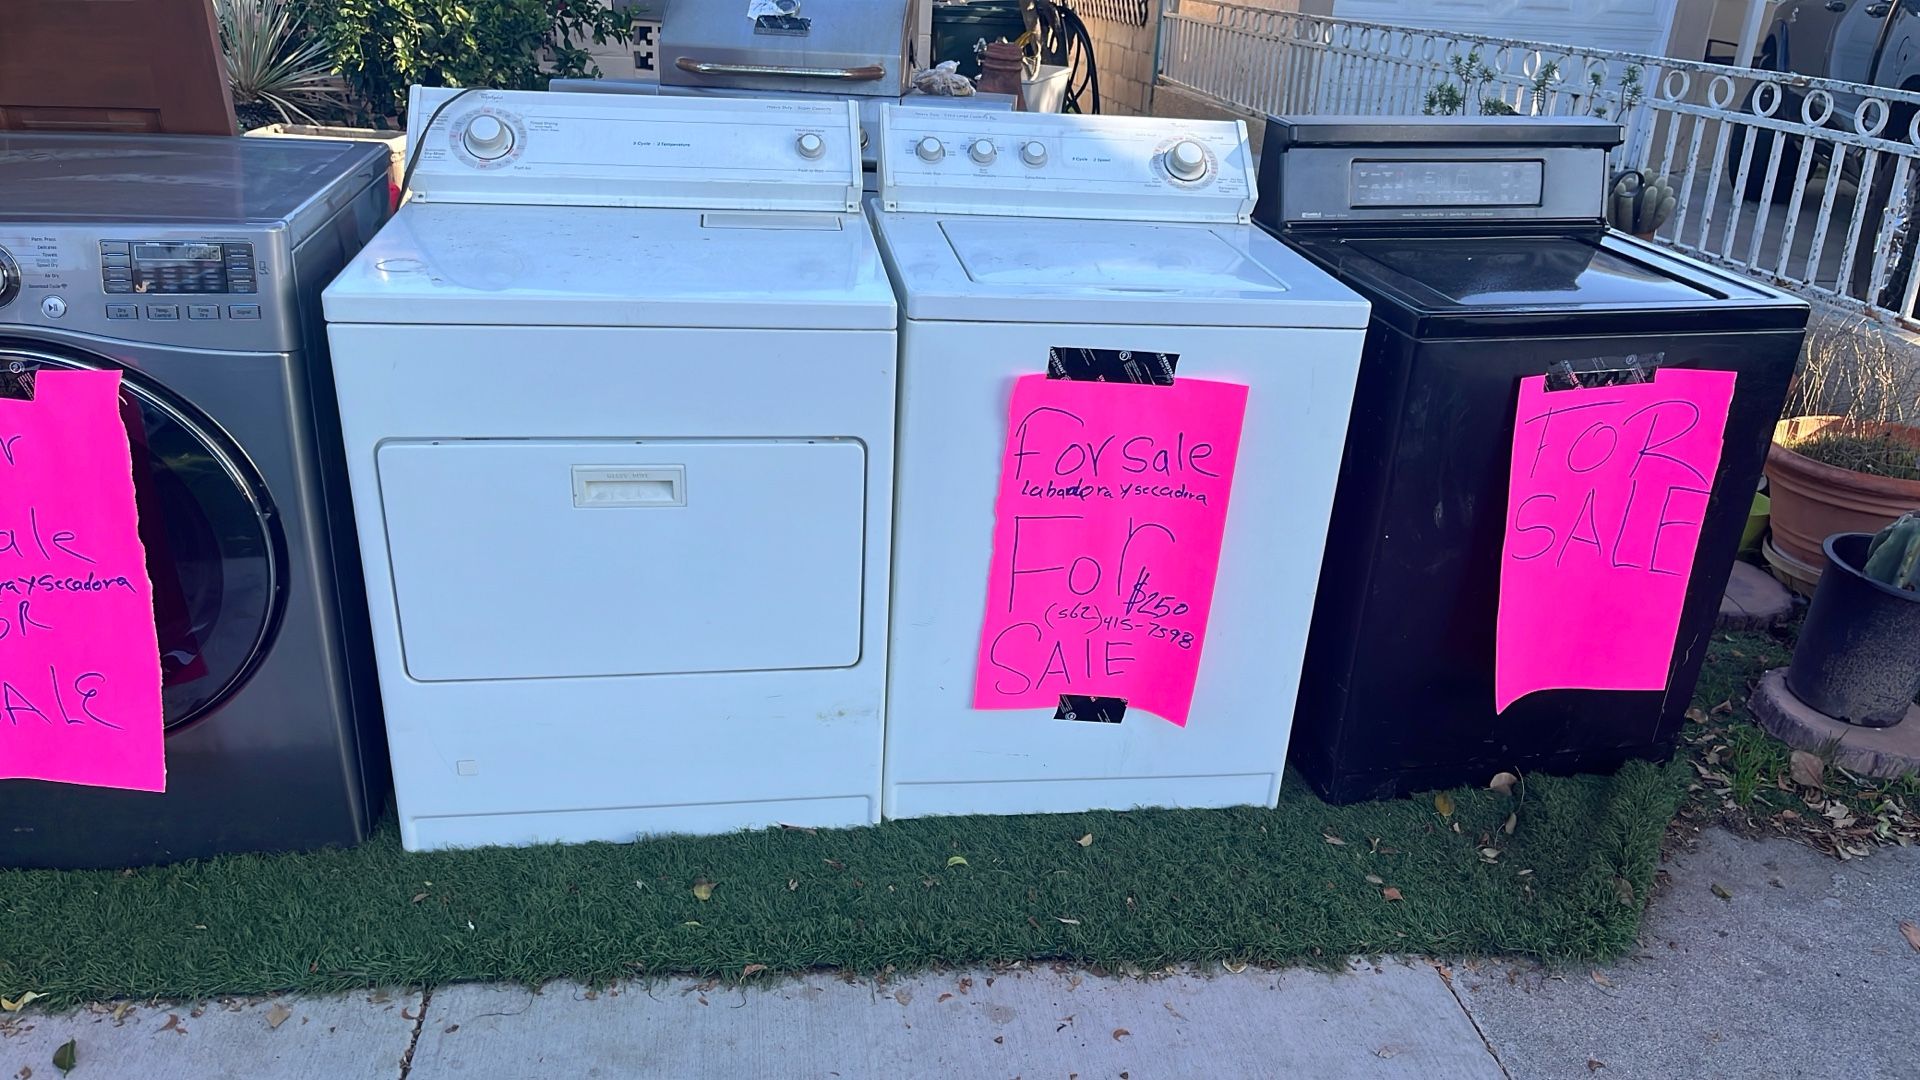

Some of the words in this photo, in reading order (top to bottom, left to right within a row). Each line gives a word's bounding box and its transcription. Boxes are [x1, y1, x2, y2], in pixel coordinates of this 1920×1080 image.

[1014, 406, 1116, 481] For
[1121, 431, 1221, 478] Sale
[1524, 399, 1710, 487] FOR
[1008, 515, 1176, 613] For
[1511, 479, 1713, 577] SALE
[0, 665, 126, 731] ALE
